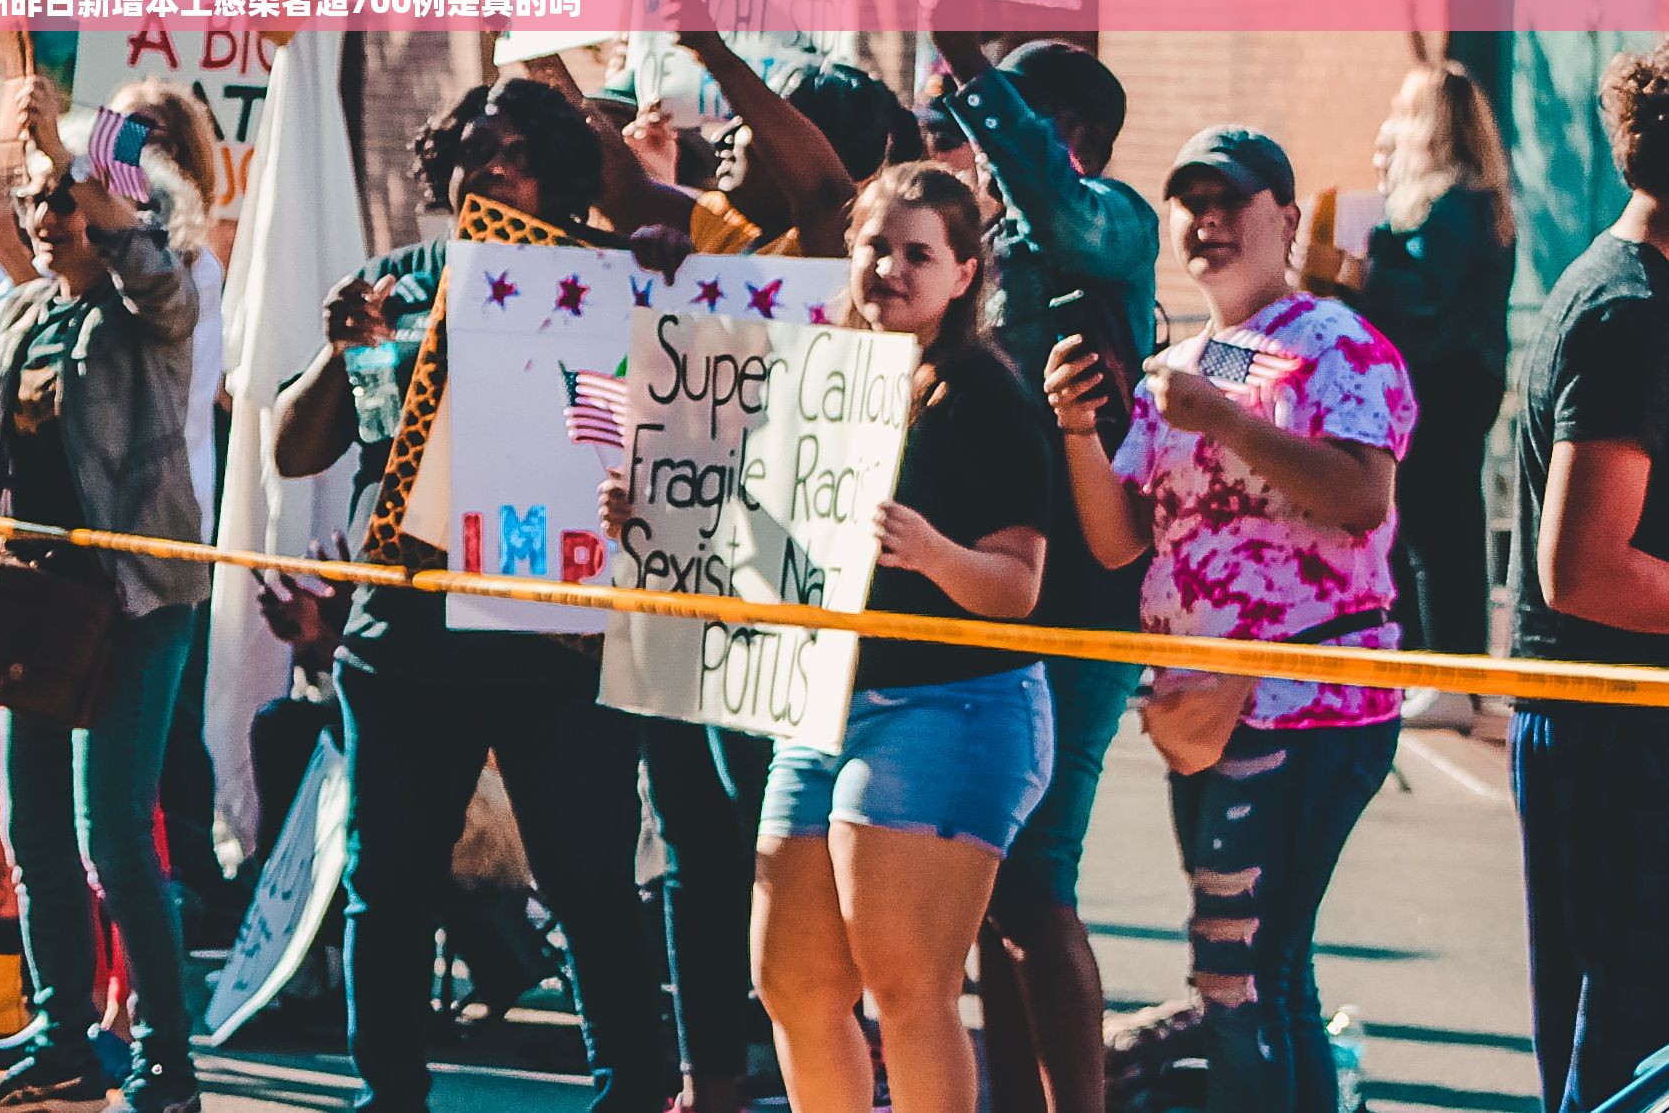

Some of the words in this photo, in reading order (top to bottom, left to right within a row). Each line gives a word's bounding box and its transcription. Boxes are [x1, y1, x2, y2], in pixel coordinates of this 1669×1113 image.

[648, 314, 788, 440] Super
[628, 423, 768, 539] Fragile
[612, 517, 741, 598] Sexist
[700, 621, 819, 727] POTUS
